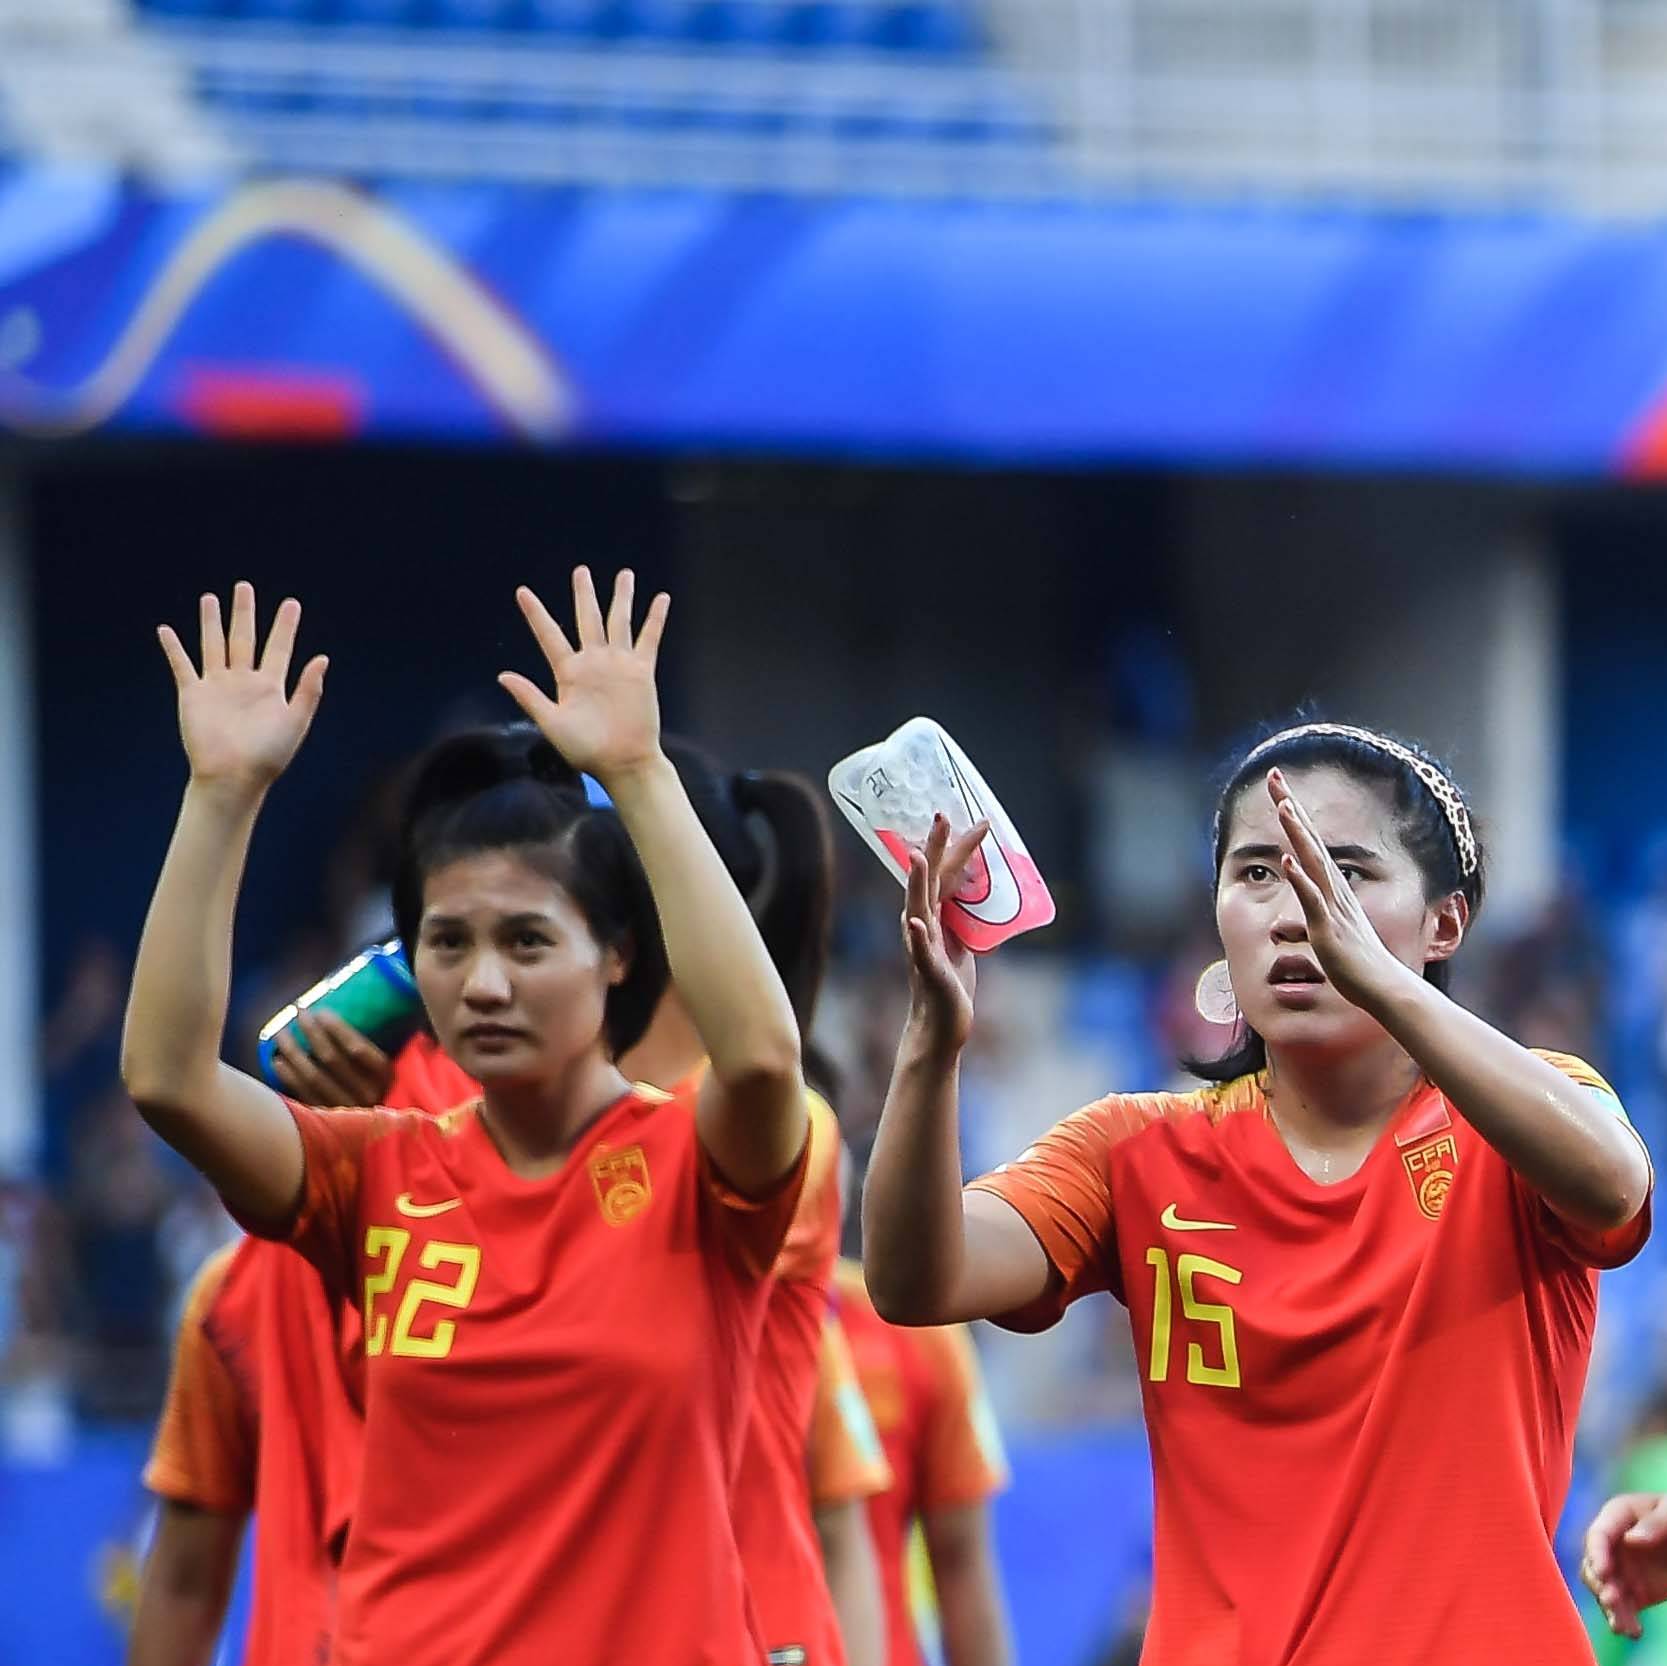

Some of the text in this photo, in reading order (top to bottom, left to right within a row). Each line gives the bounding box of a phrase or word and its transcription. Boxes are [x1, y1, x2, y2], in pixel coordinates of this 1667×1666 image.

[1407, 1140, 1452, 1171] CFA
[364, 1226, 482, 1359] 22
[1145, 1247, 1242, 1388] 15
